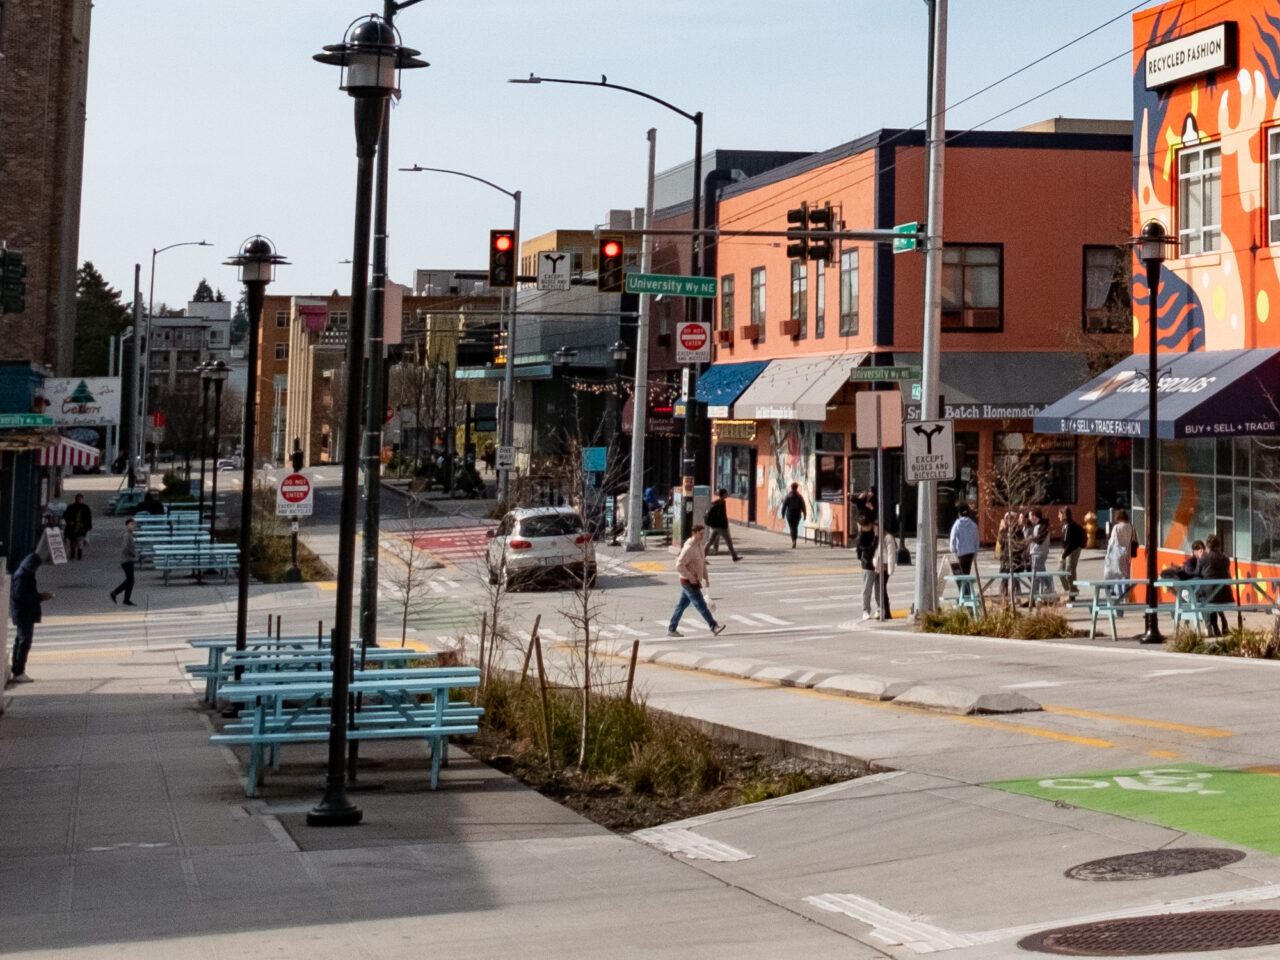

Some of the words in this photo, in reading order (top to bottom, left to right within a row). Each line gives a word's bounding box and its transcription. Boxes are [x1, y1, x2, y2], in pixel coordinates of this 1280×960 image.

[1148, 50, 1185, 74] RECYCLED
[1187, 38, 1222, 63] FASHION
[629, 277, 682, 293] University
[685, 282, 699, 293] Wy
[701, 283, 715, 293] NE
[850, 367, 889, 380] University
[944, 405, 980, 419] Batch
[983, 404, 1040, 419] Homemade
[1061, 418, 1072, 433] BUY
[1077, 419, 1090, 433] SELL
[1095, 419, 1114, 434] TRADE
[1114, 419, 1141, 435] FASHION
[1185, 424, 1204, 434] BUY
[1213, 423, 1236, 433] SELL
[1244, 421, 1276, 431] TRADE
[915, 454, 945, 464] EXCEPT
[911, 463, 932, 472] BUSES
[935, 462, 949, 470] AND
[914, 470, 947, 480] BICYCLES
